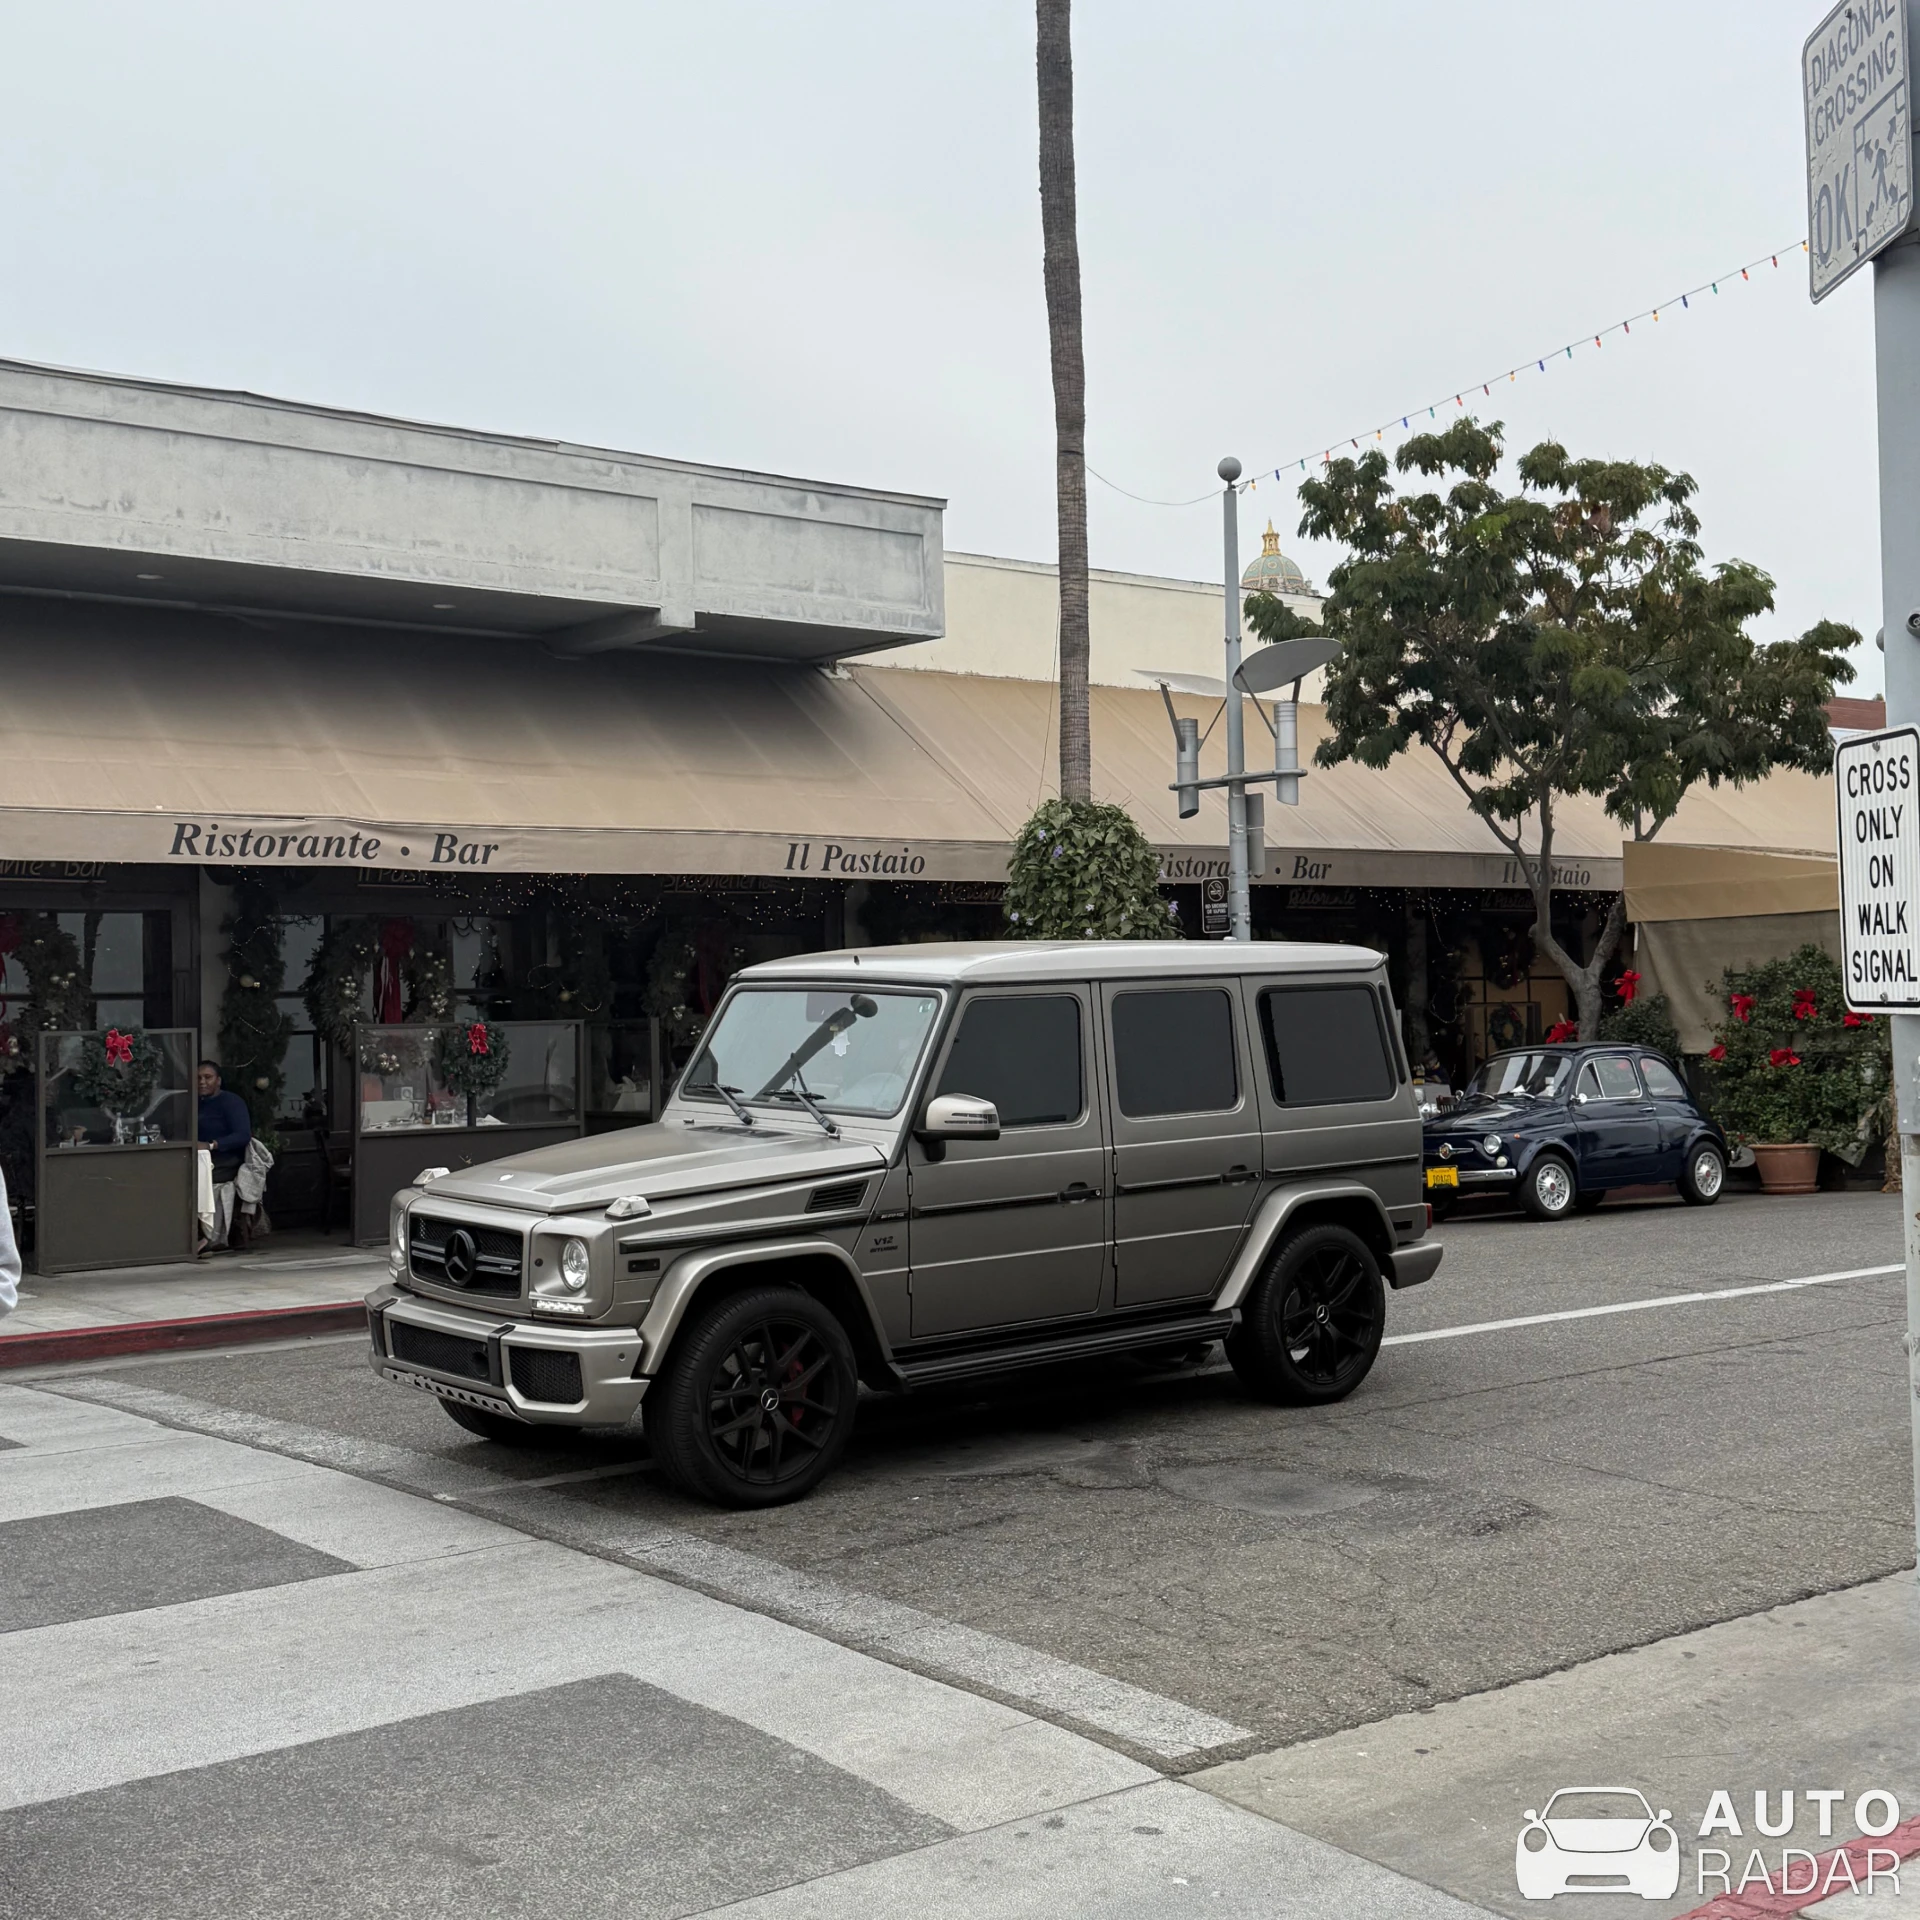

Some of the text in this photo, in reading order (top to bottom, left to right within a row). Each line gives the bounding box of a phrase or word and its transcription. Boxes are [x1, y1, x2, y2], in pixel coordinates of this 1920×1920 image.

[1814, 30, 1896, 147] CROSSING
[1816, 162, 1853, 265] OK
[1847, 755, 1910, 798] CROSS
[1856, 804, 1904, 843] ONLY
[168, 822, 500, 865] Ristorante Bar
[784, 842, 926, 875] Il Pastaio
[1291, 855, 1332, 880] Bar
[1502, 861, 1518, 884] Il
[1869, 854, 1894, 889] ON
[1858, 901, 1908, 936] WALK
[1852, 949, 1918, 983] SIGNAL
[874, 1236, 894, 1245] V12
